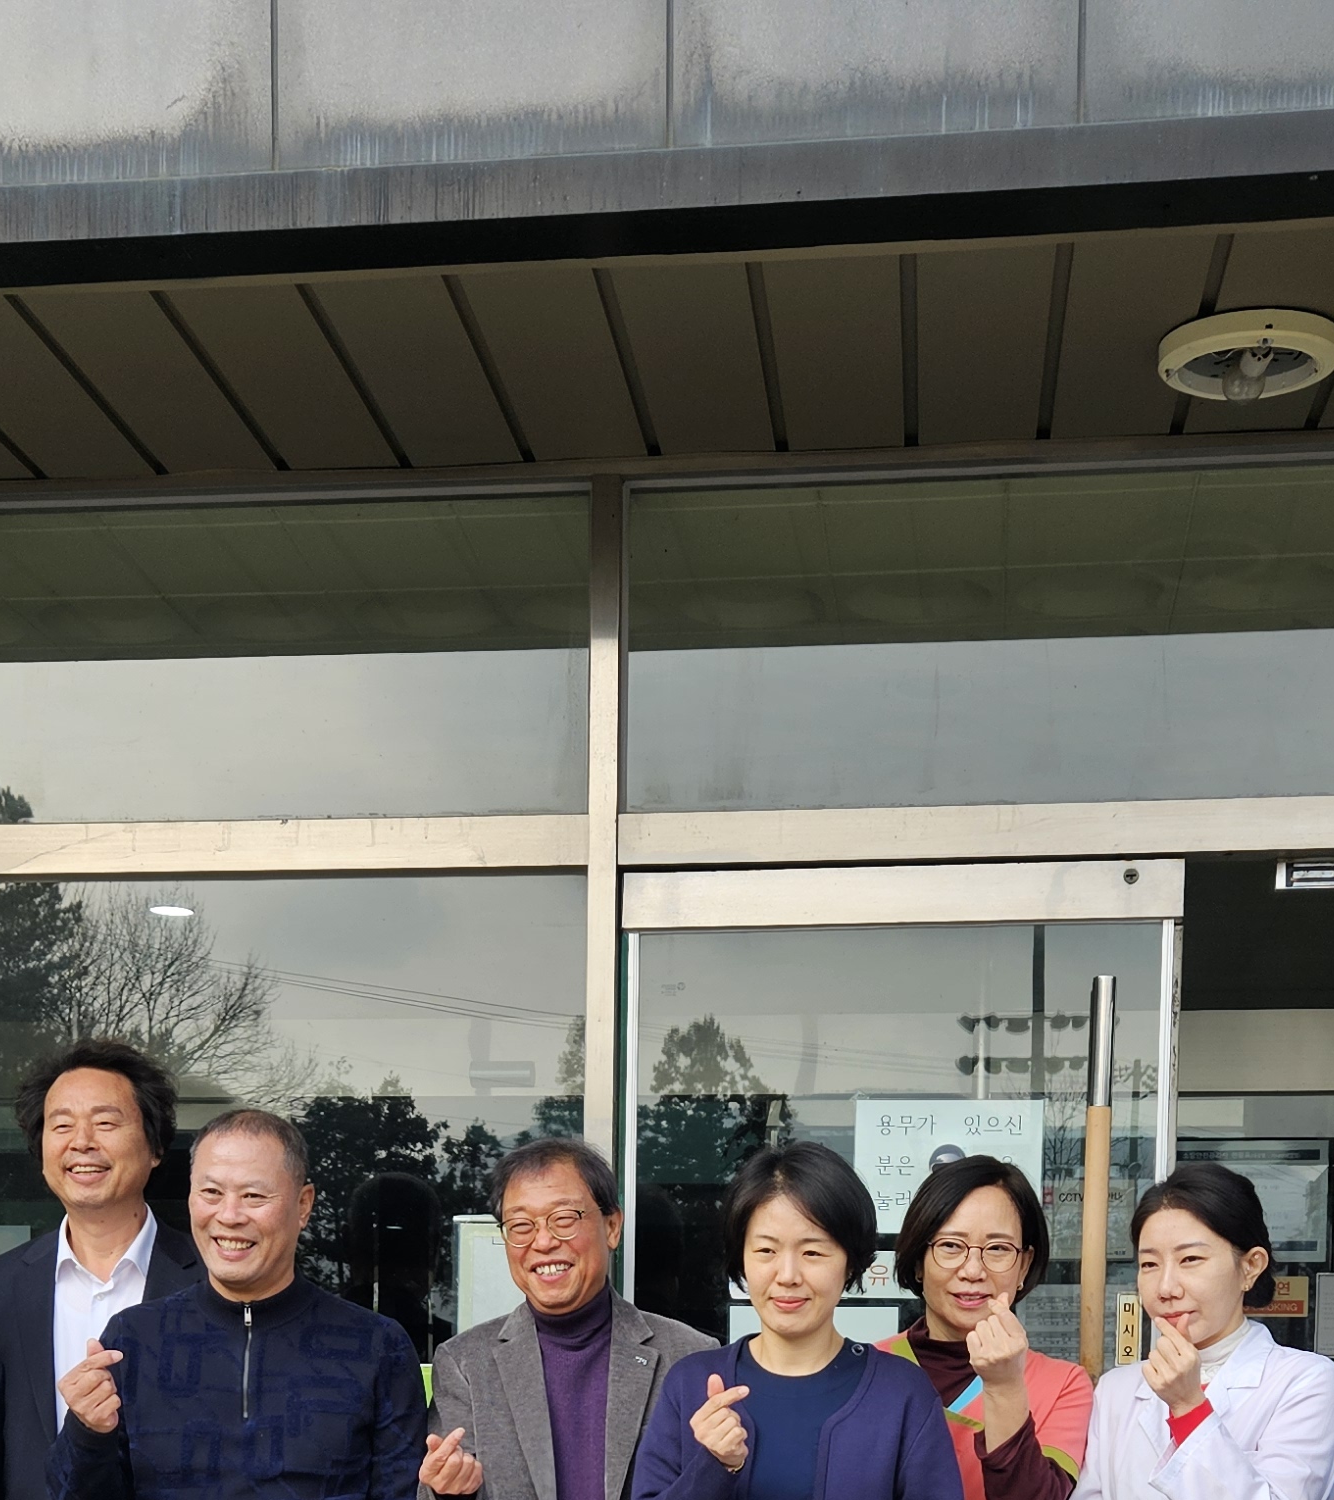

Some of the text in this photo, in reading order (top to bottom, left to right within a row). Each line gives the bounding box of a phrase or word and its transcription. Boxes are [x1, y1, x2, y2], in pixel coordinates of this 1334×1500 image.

[875, 1113, 1024, 1137] 용무가 있으신
[874, 1154, 915, 1177] 분은
[1121, 1302, 1135, 1357] 미시오
